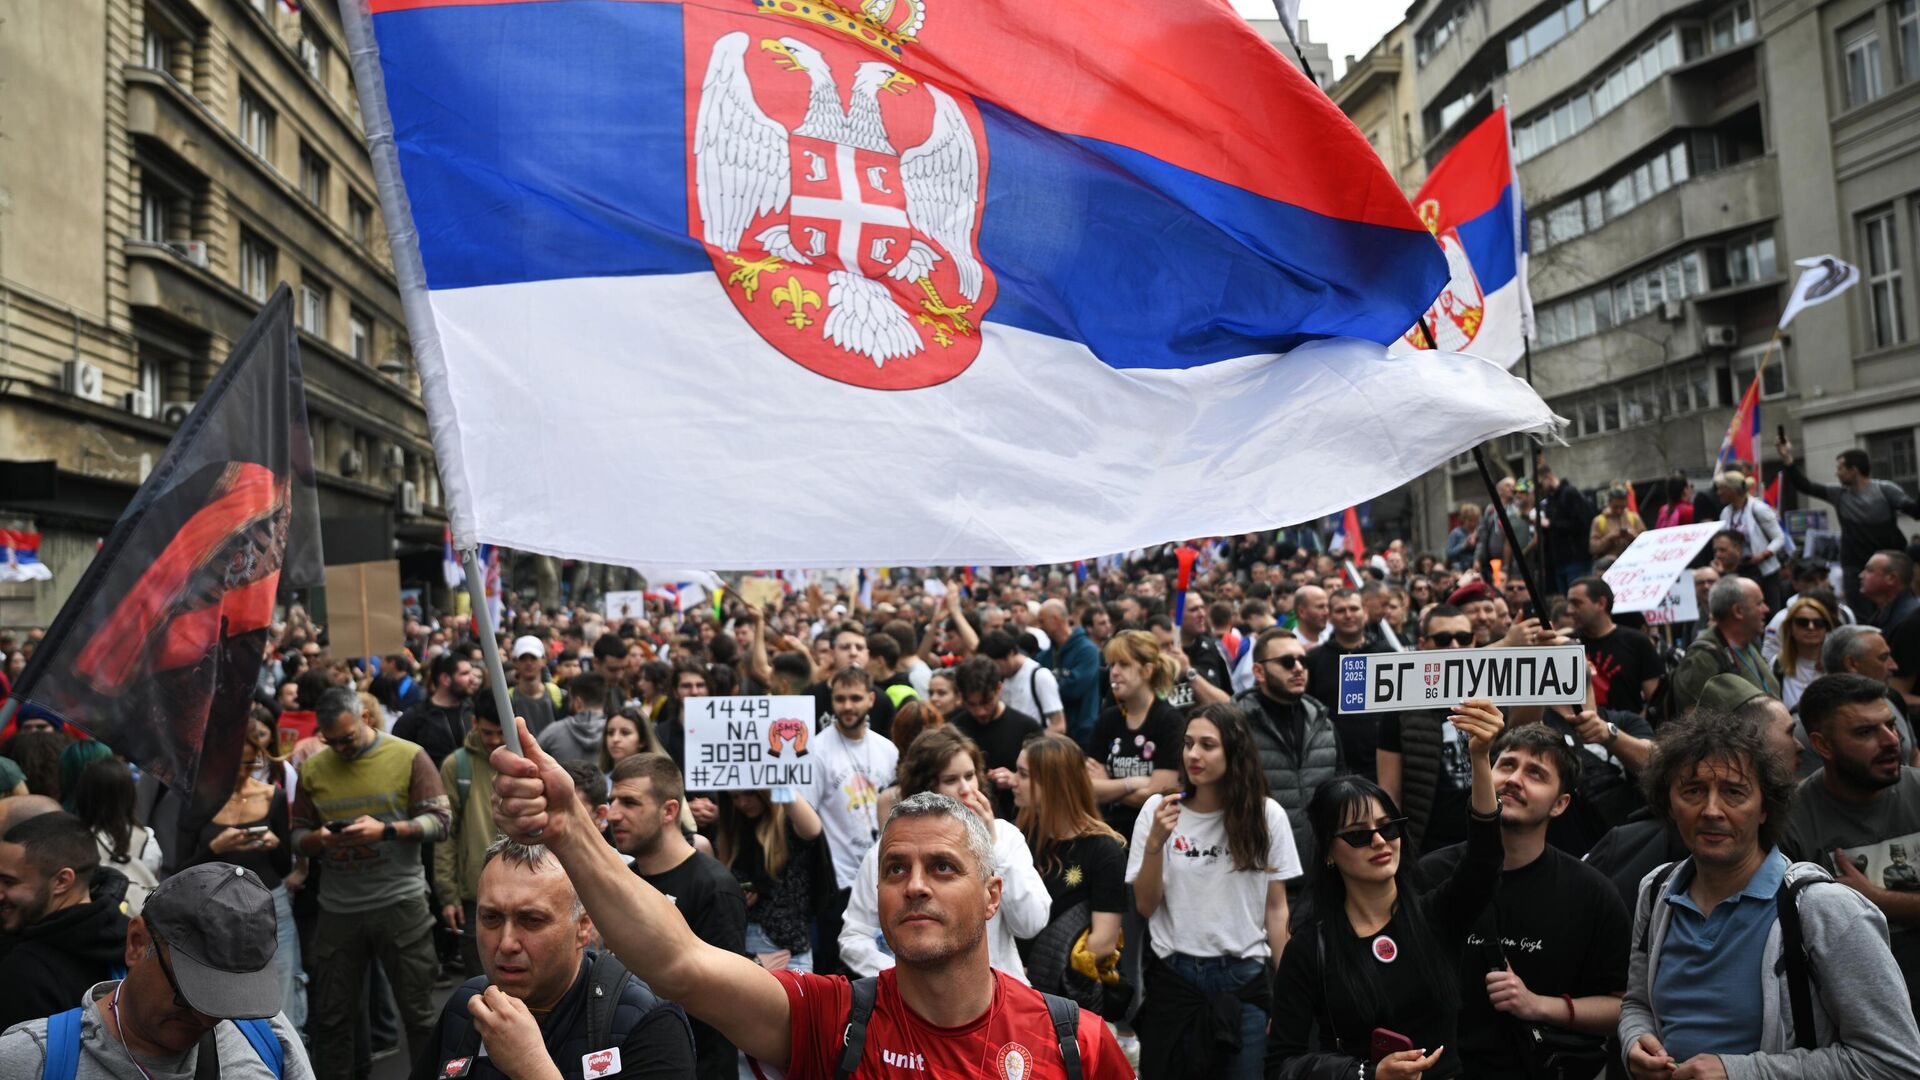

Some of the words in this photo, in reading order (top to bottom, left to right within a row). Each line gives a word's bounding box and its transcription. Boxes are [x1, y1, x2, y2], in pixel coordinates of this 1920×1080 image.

[1344, 660, 1366, 670] 15.03.
[1344, 671, 1365, 682] 2025.
[1374, 662, 1415, 703] БГ
[1443, 656, 1578, 698] ПУМПАЈ
[1345, 693, 1364, 704] СРБ
[1425, 688, 1438, 699] BG
[706, 699, 769, 719] 1449
[728, 721, 758, 740] NA
[777, 722, 801, 732] SMS
[701, 743, 762, 763] 3030
[691, 765, 741, 786] #ZA
[750, 764, 812, 786] VOJKU
[1520, 937, 1543, 952] Gogh
[589, 1053, 613, 1067] PUMPAJ
[883, 1049, 925, 1071] unit
